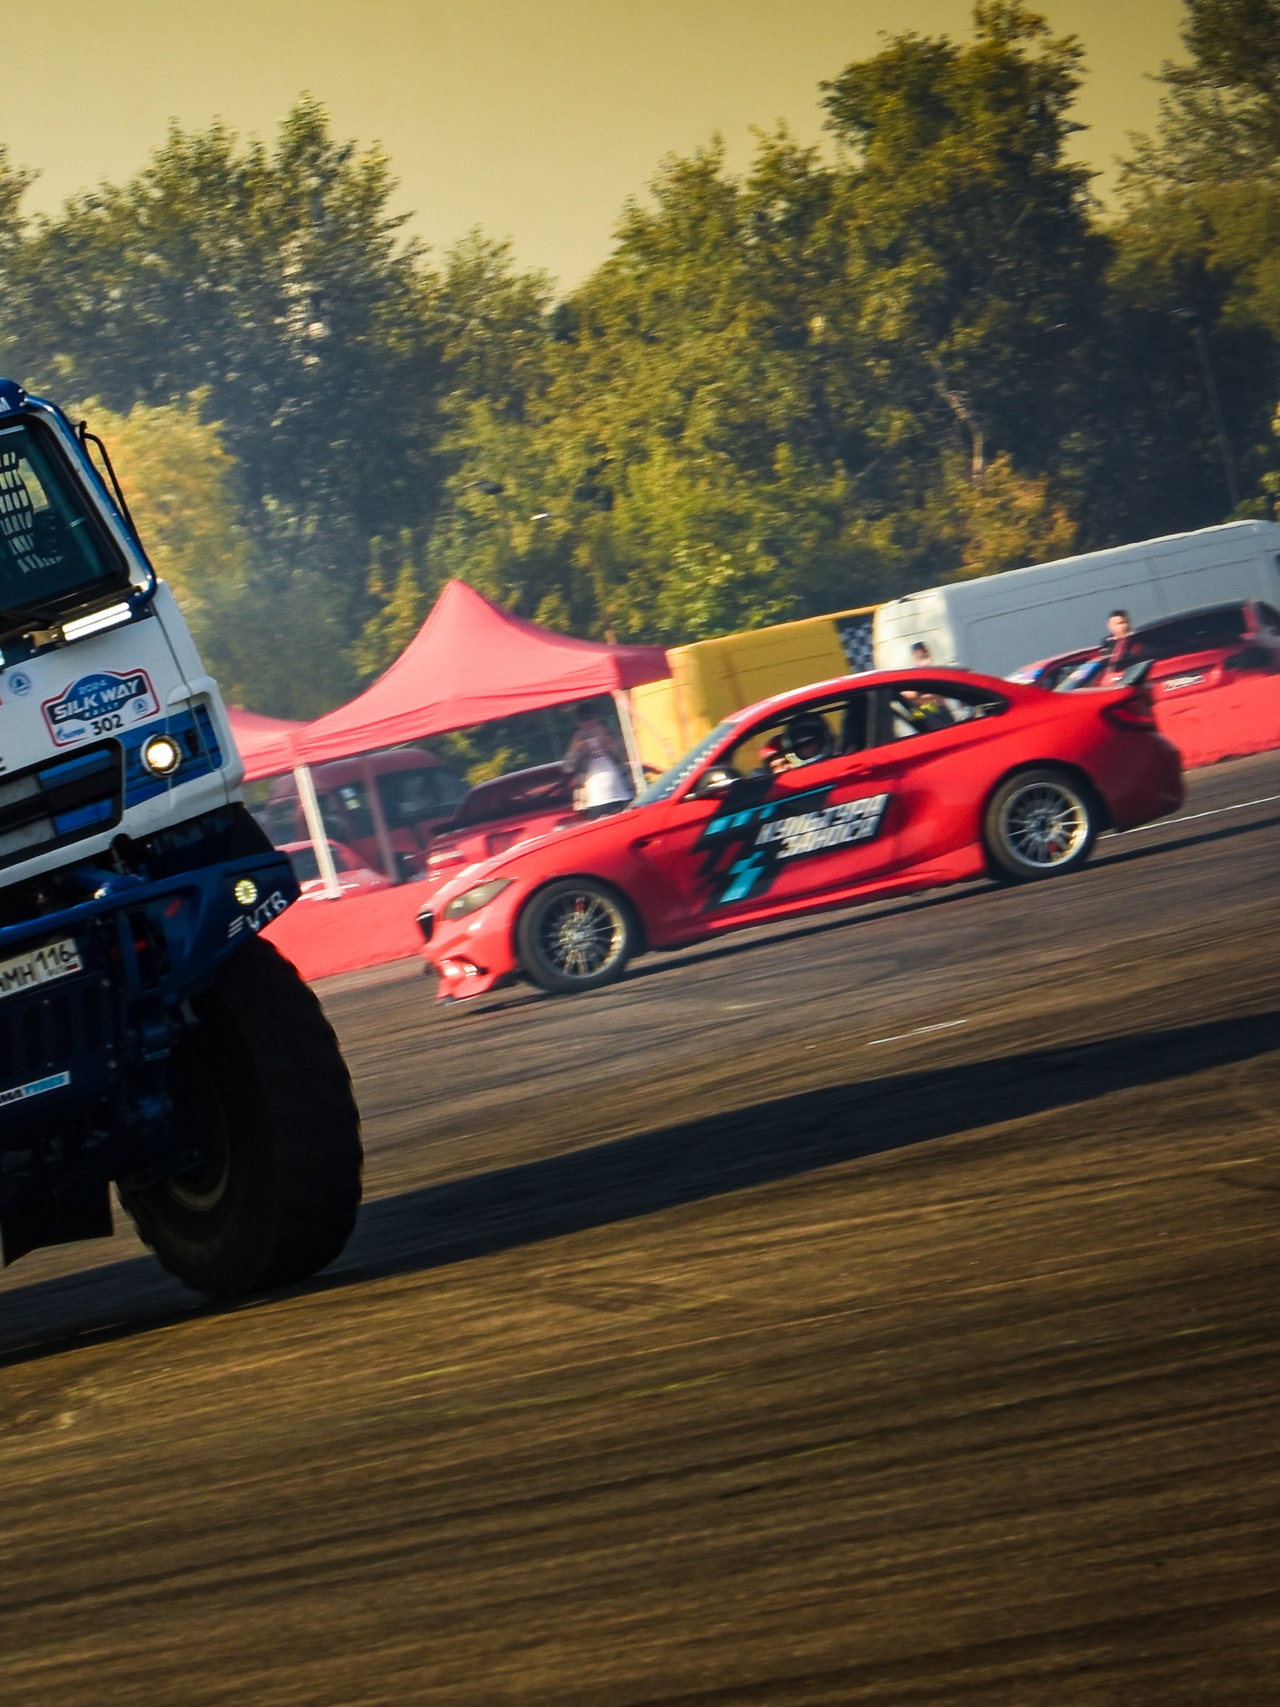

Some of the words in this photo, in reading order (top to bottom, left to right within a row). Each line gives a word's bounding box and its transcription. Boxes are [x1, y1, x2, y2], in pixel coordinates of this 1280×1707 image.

[53, 694, 99, 720] SILK
[100, 679, 139, 703] WAY
[90, 714, 125, 736] 302
[246, 890, 288, 932] VTB
[35, 944, 71, 970] 116
